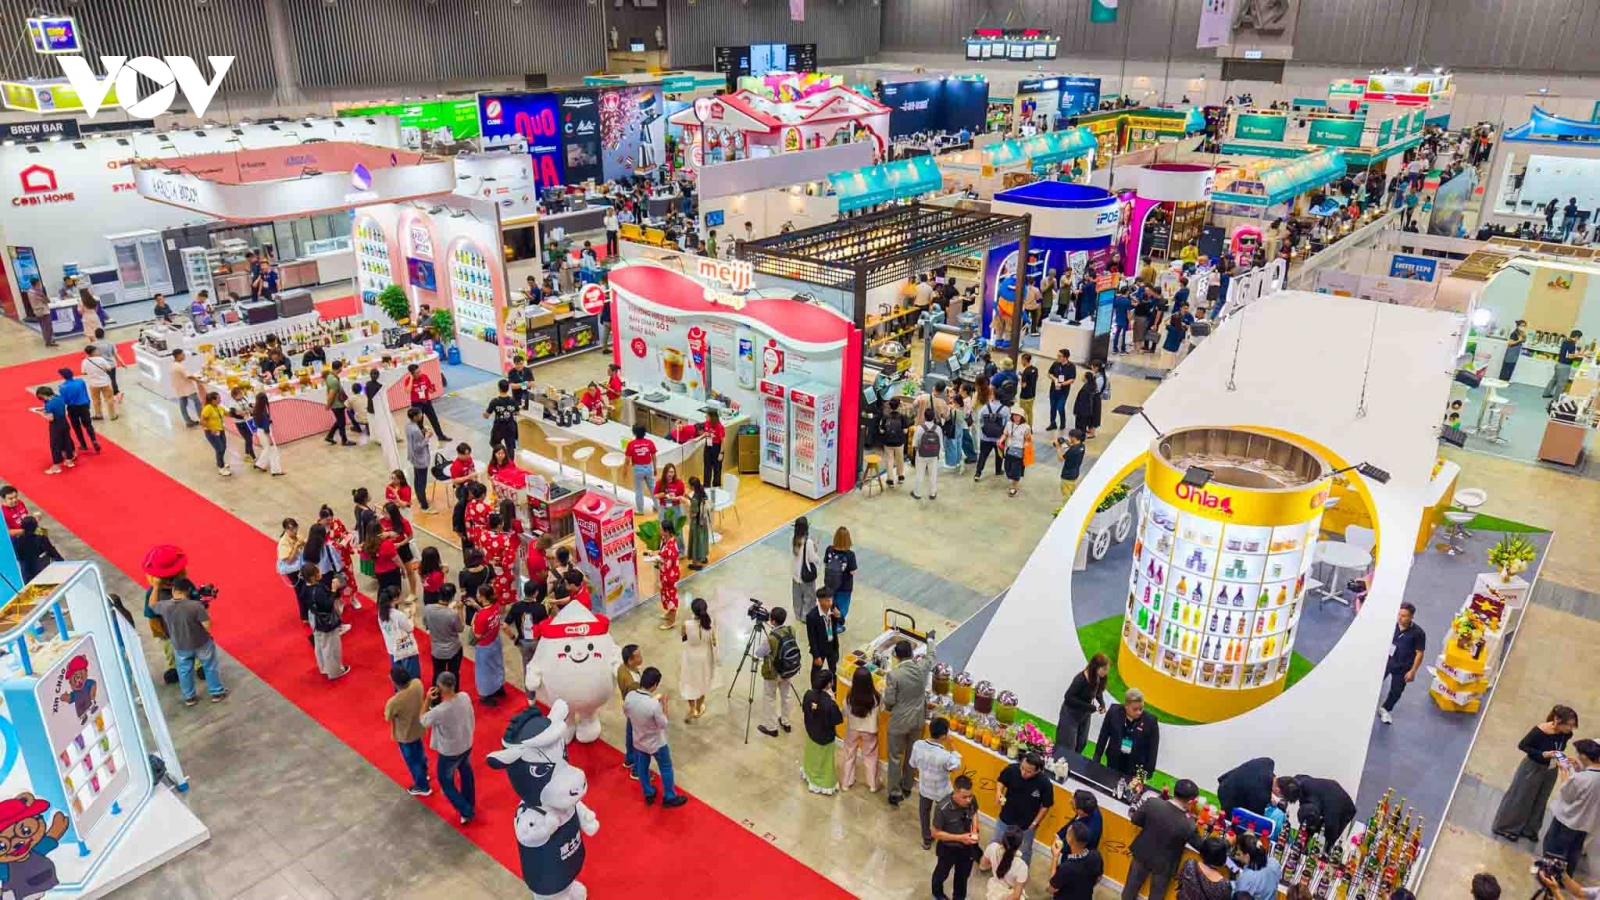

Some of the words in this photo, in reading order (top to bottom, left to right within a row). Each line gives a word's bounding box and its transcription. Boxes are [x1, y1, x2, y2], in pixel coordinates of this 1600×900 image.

[10, 124, 40, 135] BREW
[42, 123, 64, 132] BAR
[43, 192, 75, 203] HOME
[700, 261, 751, 290] meiji
[1175, 481, 1218, 508] Ohla
[578, 518, 598, 534] meiji
[567, 624, 588, 634] meiji
